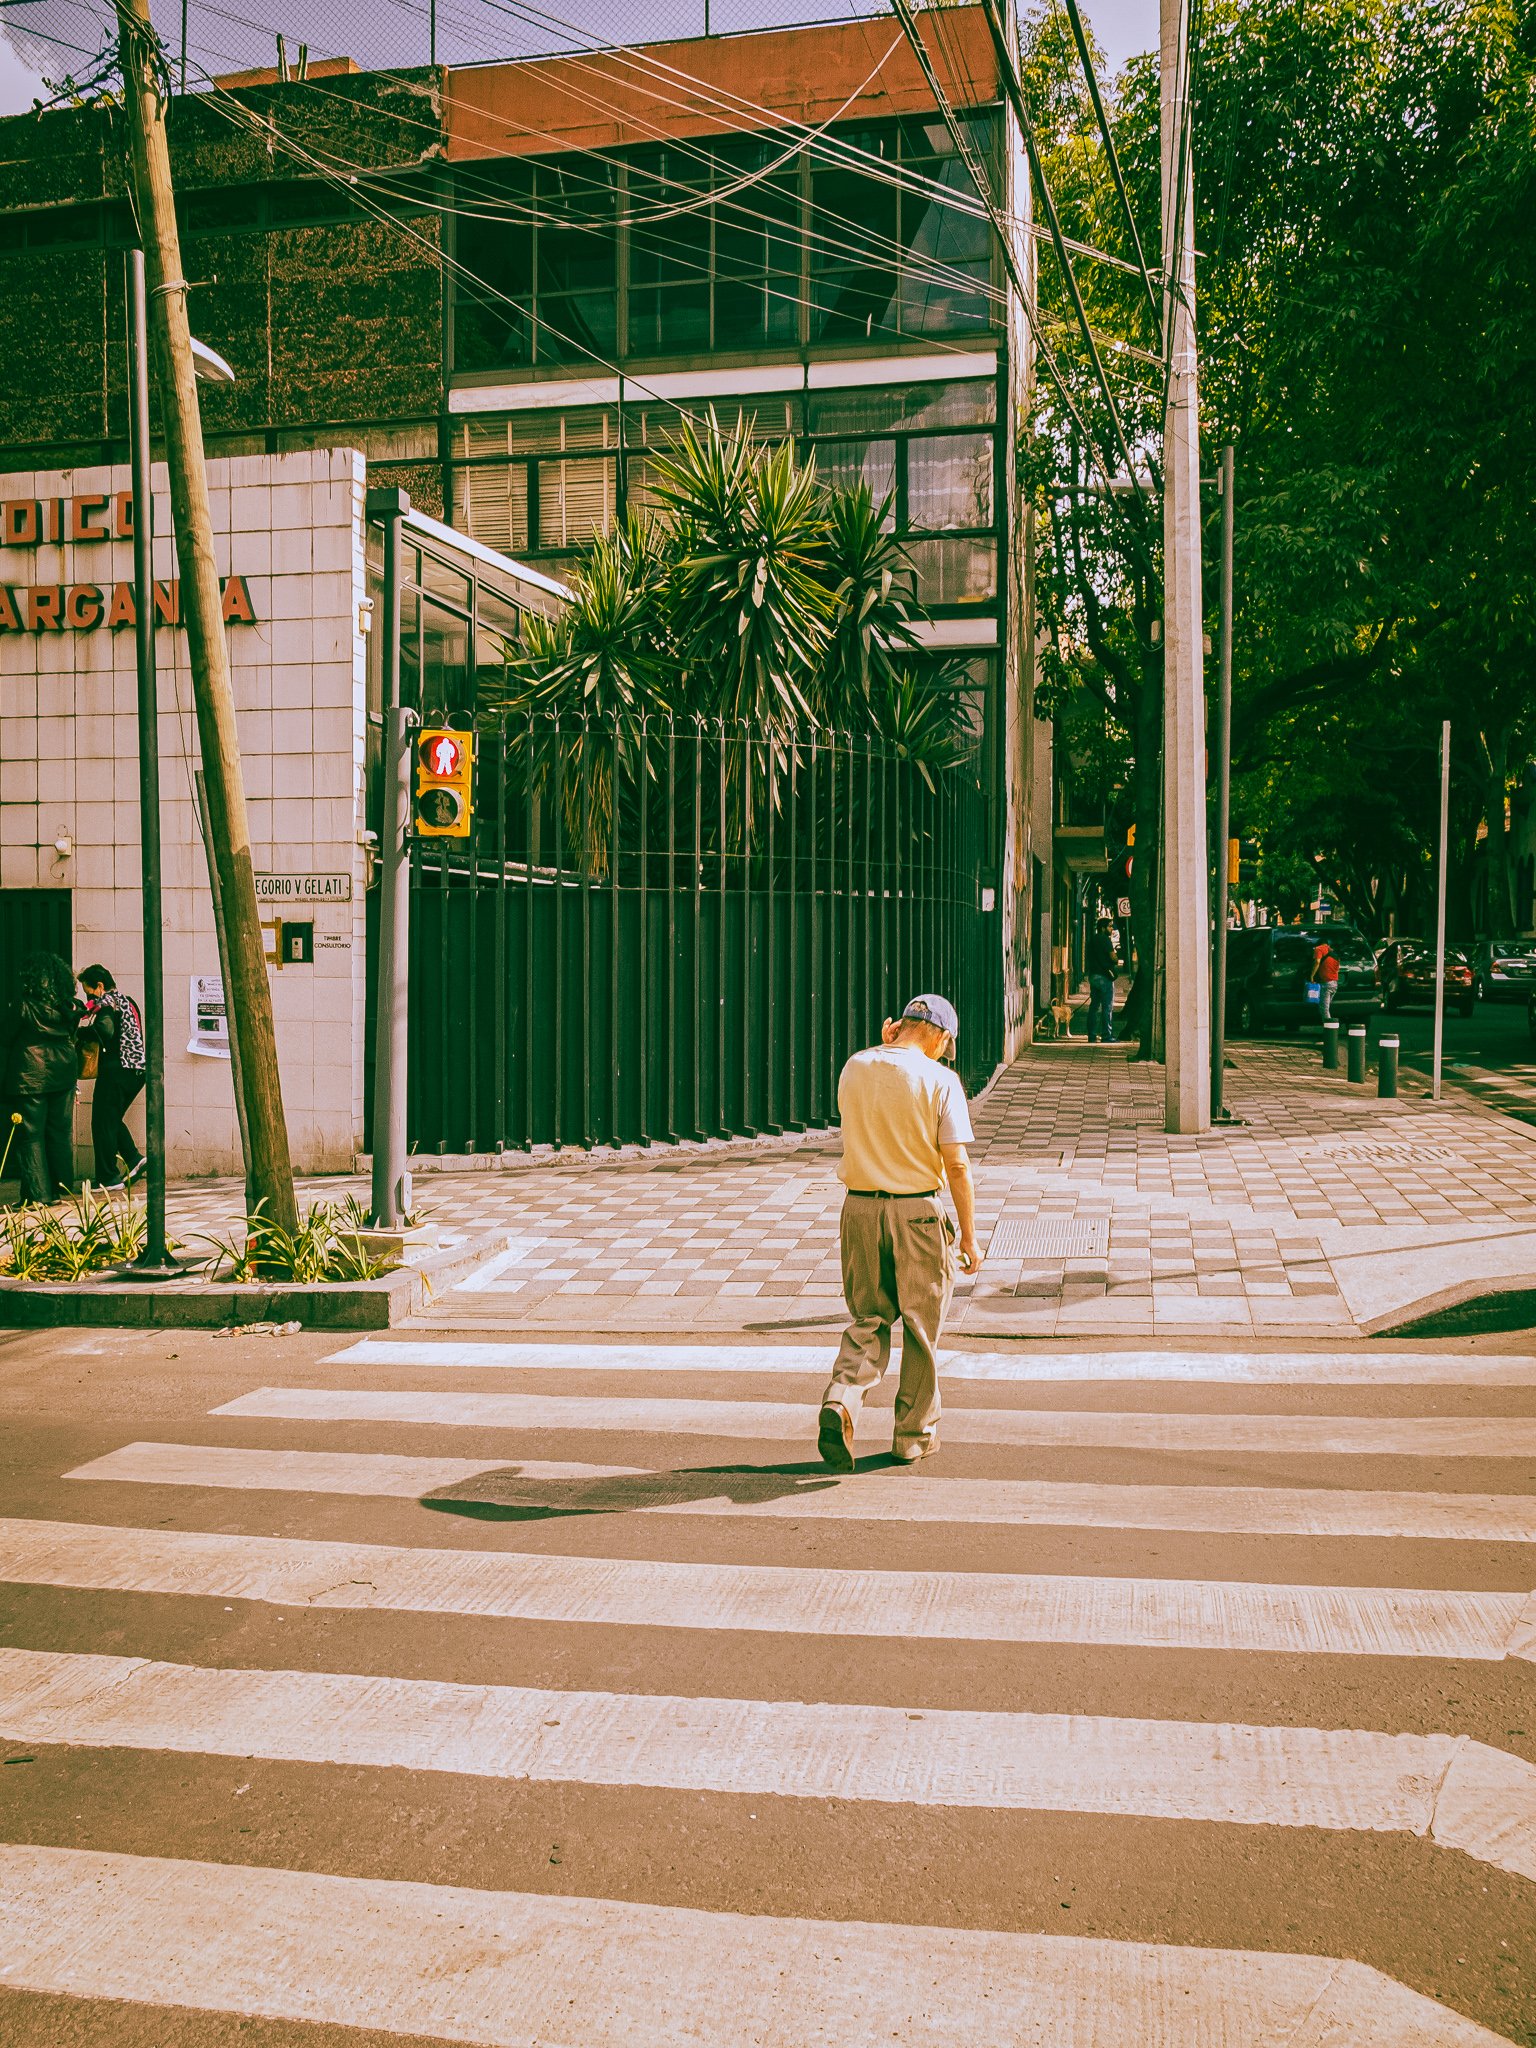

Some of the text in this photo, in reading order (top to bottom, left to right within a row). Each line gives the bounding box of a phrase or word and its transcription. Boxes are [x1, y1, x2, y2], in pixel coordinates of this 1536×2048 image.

[0, 576, 254, 631] ARGANA
[255, 879, 292, 895] EGORIO
[304, 879, 342, 895] GELATI
